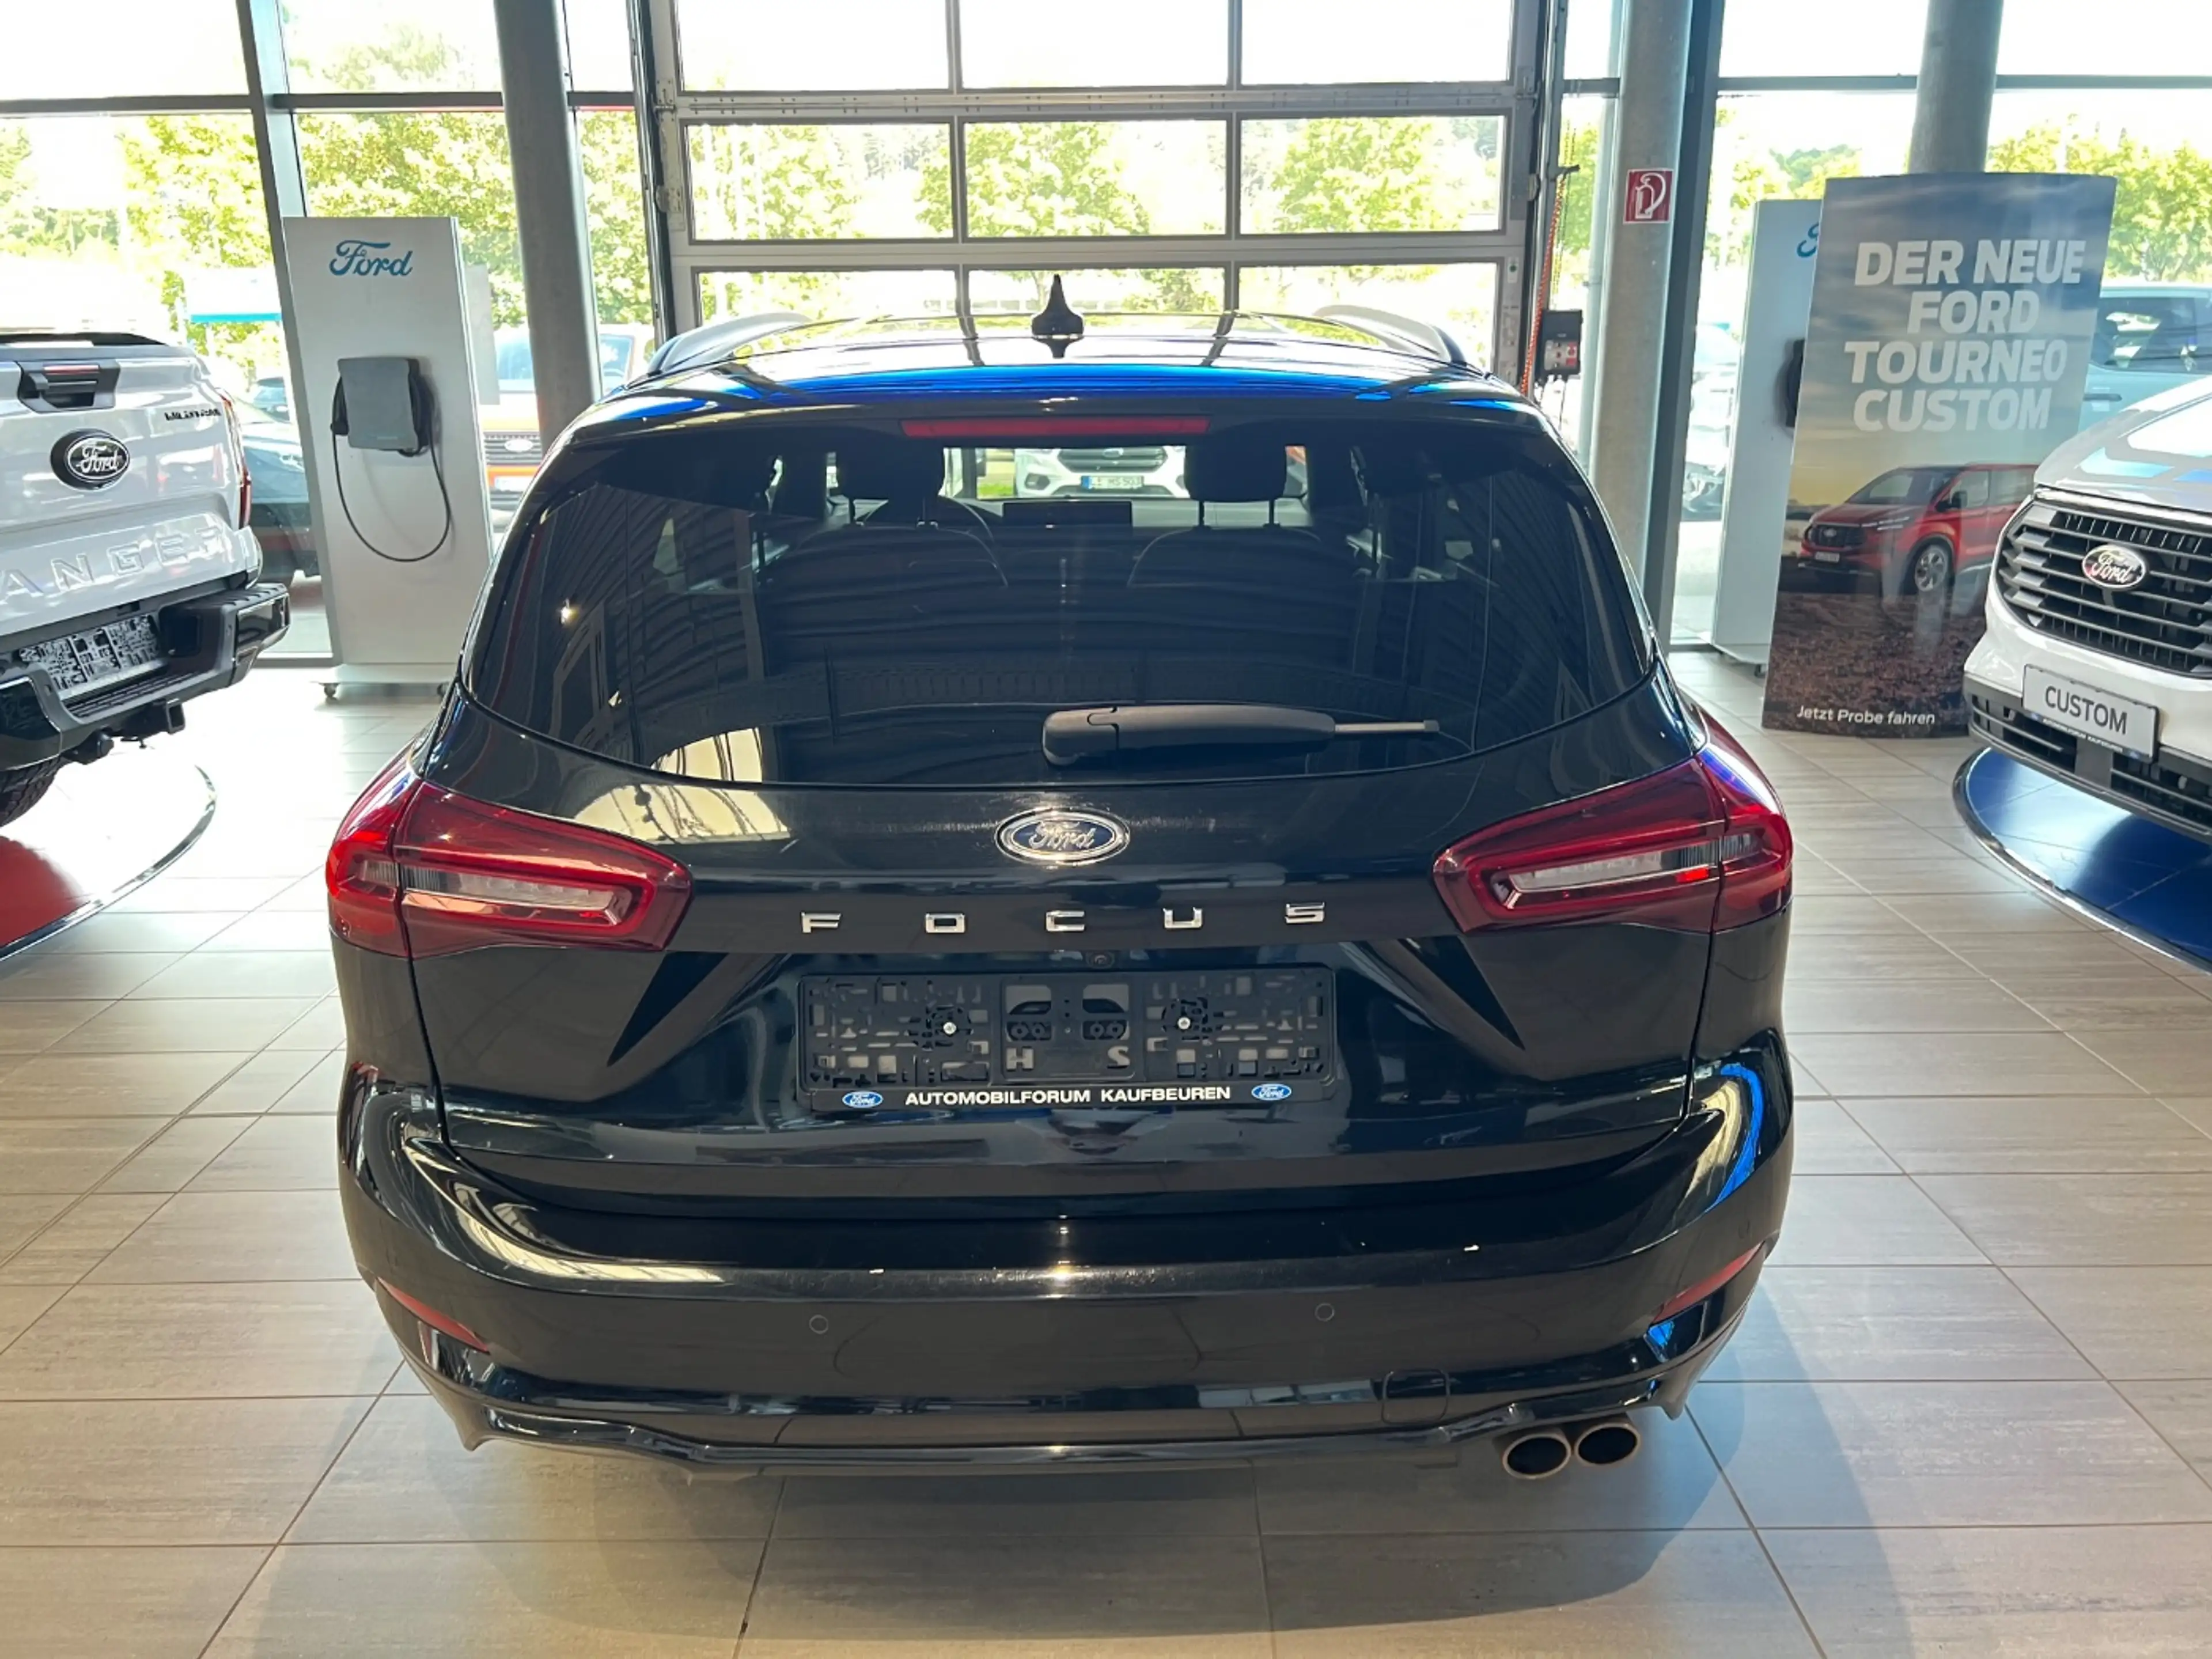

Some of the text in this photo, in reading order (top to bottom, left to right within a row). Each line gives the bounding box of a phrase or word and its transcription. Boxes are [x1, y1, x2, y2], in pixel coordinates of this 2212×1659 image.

[329, 240, 413, 276] Ford
[1854, 240, 1964, 286] DER
[1973, 239, 2086, 284] NEUE
[1907, 290, 2040, 335] FORD
[1844, 339, 2068, 384] TOURNEO
[1853, 387, 2052, 433] CUSTOM
[75, 445, 119, 474] Ford
[2090, 551, 2134, 584] Ford
[1797, 704, 1936, 725] Jetzt Probe fahren
[2045, 685, 2127, 735] CUSTOM
[1028, 820, 1097, 850] Ford
[801, 902, 1325, 934] FOCUS
[905, 1090, 1090, 1106] AUTOMOBILFORUM
[1101, 1086, 1230, 1103] KAUFBEUREN
